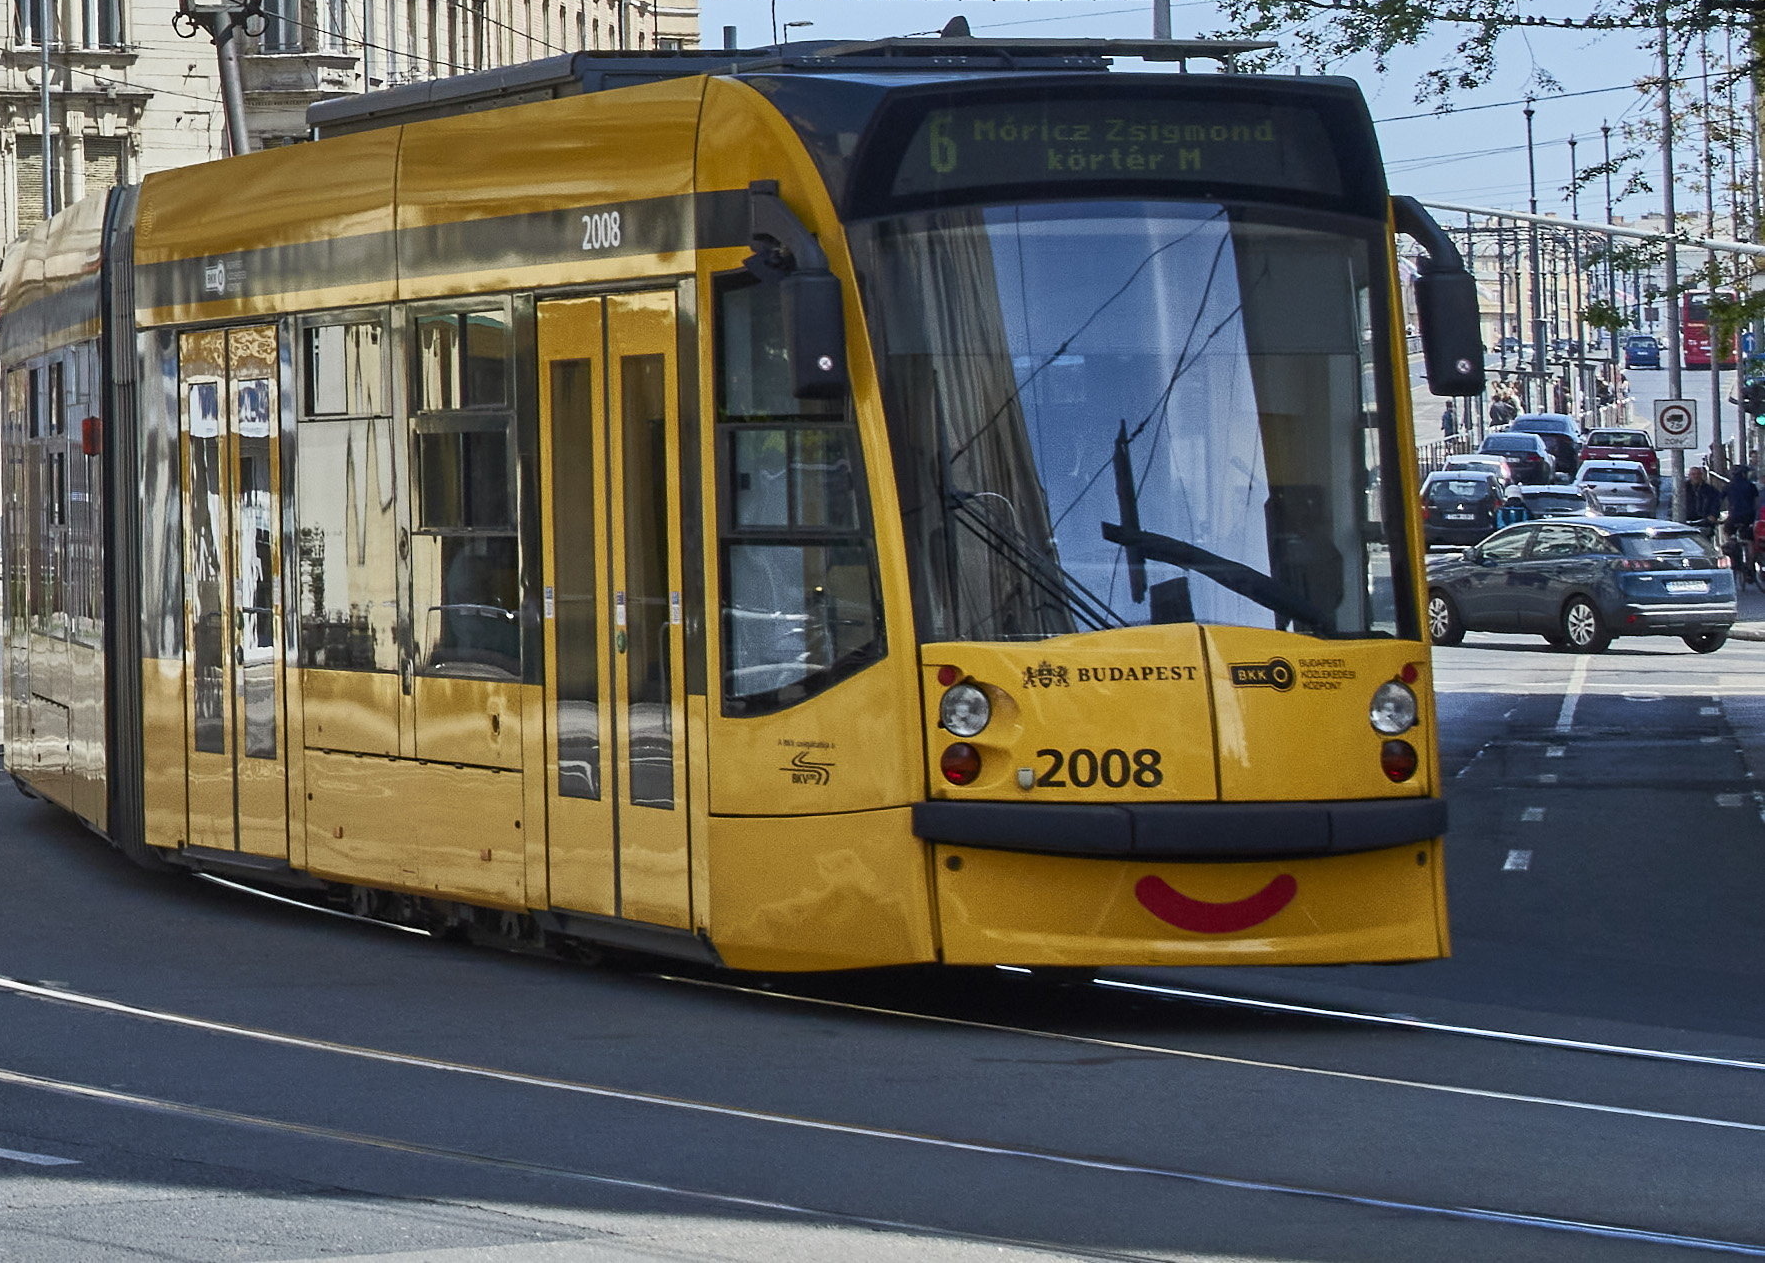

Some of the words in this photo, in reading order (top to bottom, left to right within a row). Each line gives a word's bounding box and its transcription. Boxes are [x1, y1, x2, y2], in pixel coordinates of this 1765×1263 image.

[929, 114, 958, 173] 6
[973, 116, 1091, 142] Móricz
[1104, 118, 1276, 144] Zsigmond
[1046, 145, 1165, 171] körtér
[1177, 147, 1203, 171] M
[581, 211, 621, 250] 2008
[1077, 666, 1196, 682] BUDAPEST
[1238, 670, 1267, 681] BKK
[1298, 658, 1346, 668] BUDAPESTI
[1036, 748, 1164, 788] 2008
